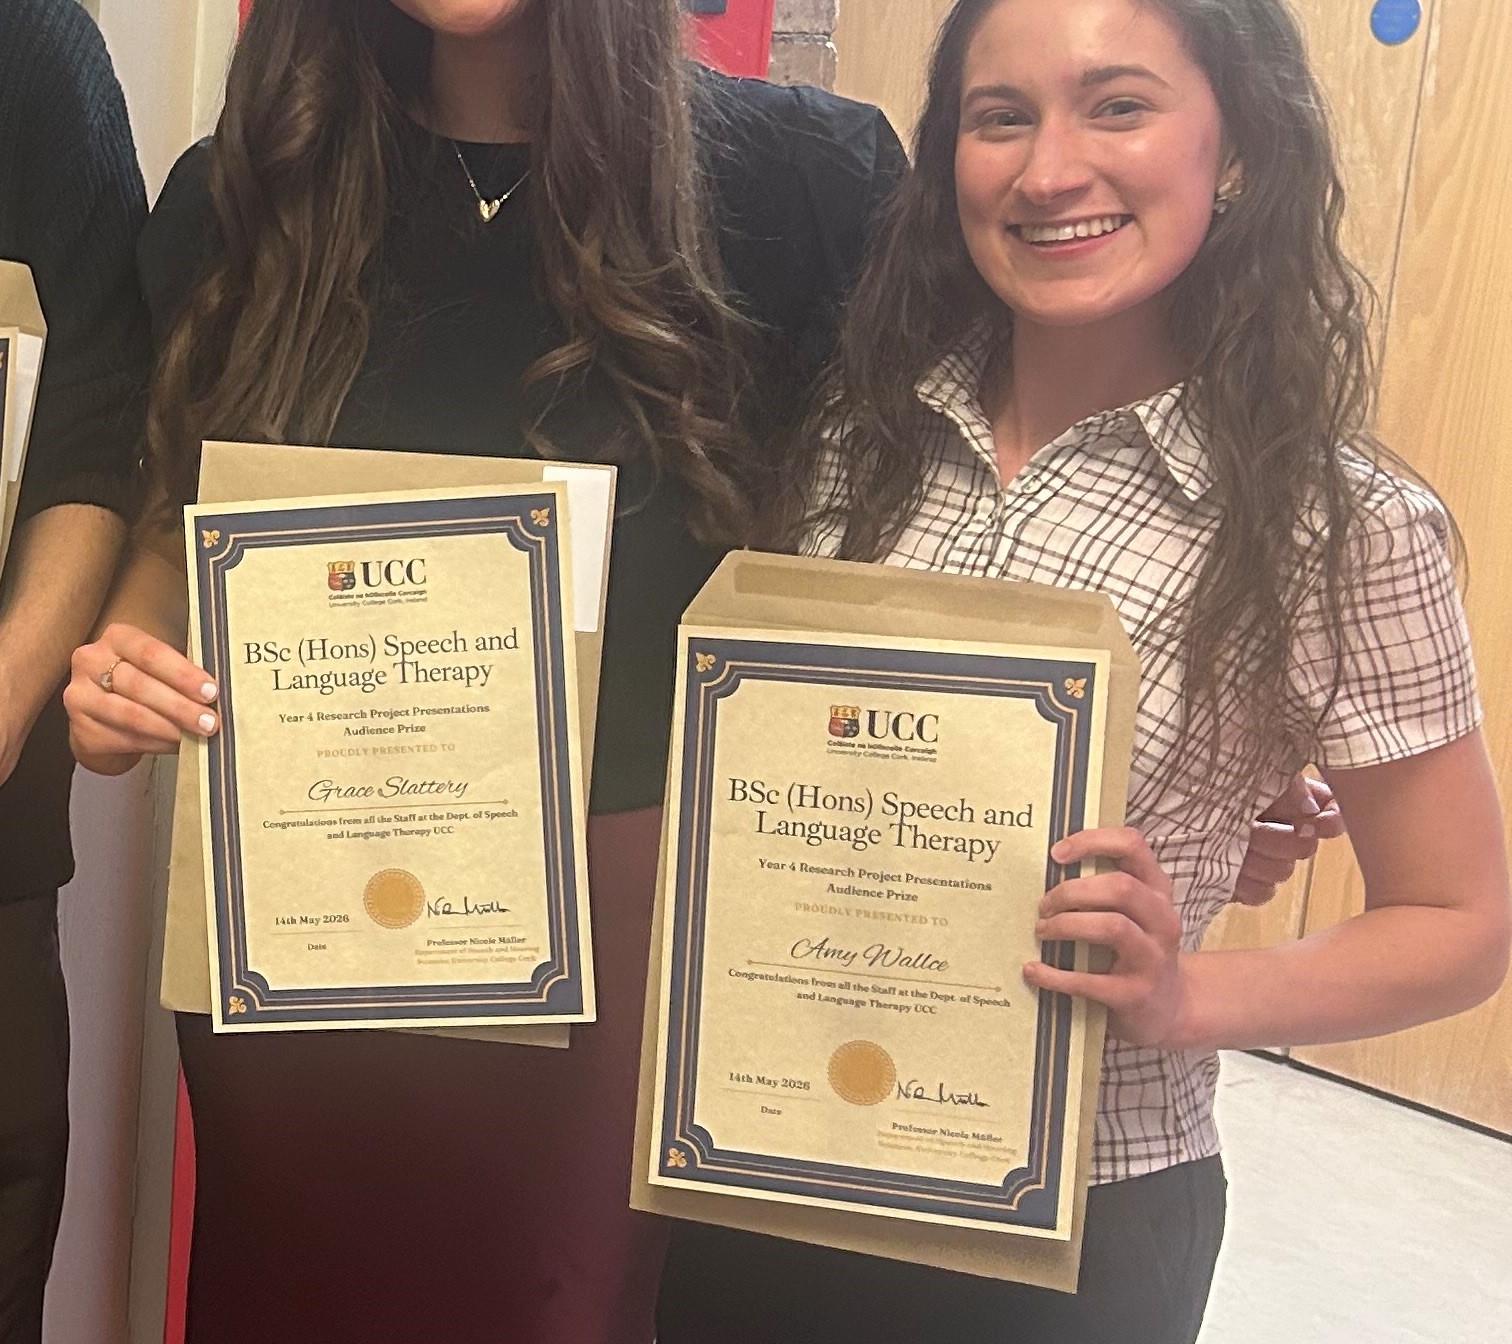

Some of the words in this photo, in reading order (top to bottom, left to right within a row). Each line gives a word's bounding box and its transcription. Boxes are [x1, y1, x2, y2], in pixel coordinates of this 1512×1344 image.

[359, 558, 426, 587] UCC
[243, 641, 291, 664] BSc
[297, 634, 376, 667] (Hons)
[383, 629, 468, 664] Speech
[475, 626, 519, 651] and
[270, 668, 387, 695] Language
[392, 660, 493, 687] Therapy
[278, 713, 304, 723] Year
[316, 709, 367, 721] Research
[369, 707, 409, 719] Project
[412, 703, 490, 716] Presentations
[866, 709, 939, 743] UCC
[343, 725, 395, 736] Audience
[396, 723, 426, 733] Prize
[727, 777, 779, 804] BSc
[787, 781, 873, 820] (Hons)
[881, 791, 975, 826] Speech
[983, 803, 1032, 828] and
[754, 810, 881, 851] Language
[888, 821, 1001, 863] Therapy
[758, 858, 786, 869] Year
[799, 862, 855, 877] Research
[857, 867, 902, 882] Project
[905, 872, 992, 891] Presentations
[825, 883, 884, 898] Audience
[886, 889, 918, 901] Prize
[275, 915, 296, 925] 14th
[299, 915, 320, 925] May
[322, 914, 349, 923] 2026
[729, 1072, 753, 1083] 14th
[755, 1075, 778, 1088] May
[780, 1077, 810, 1091] 2026
